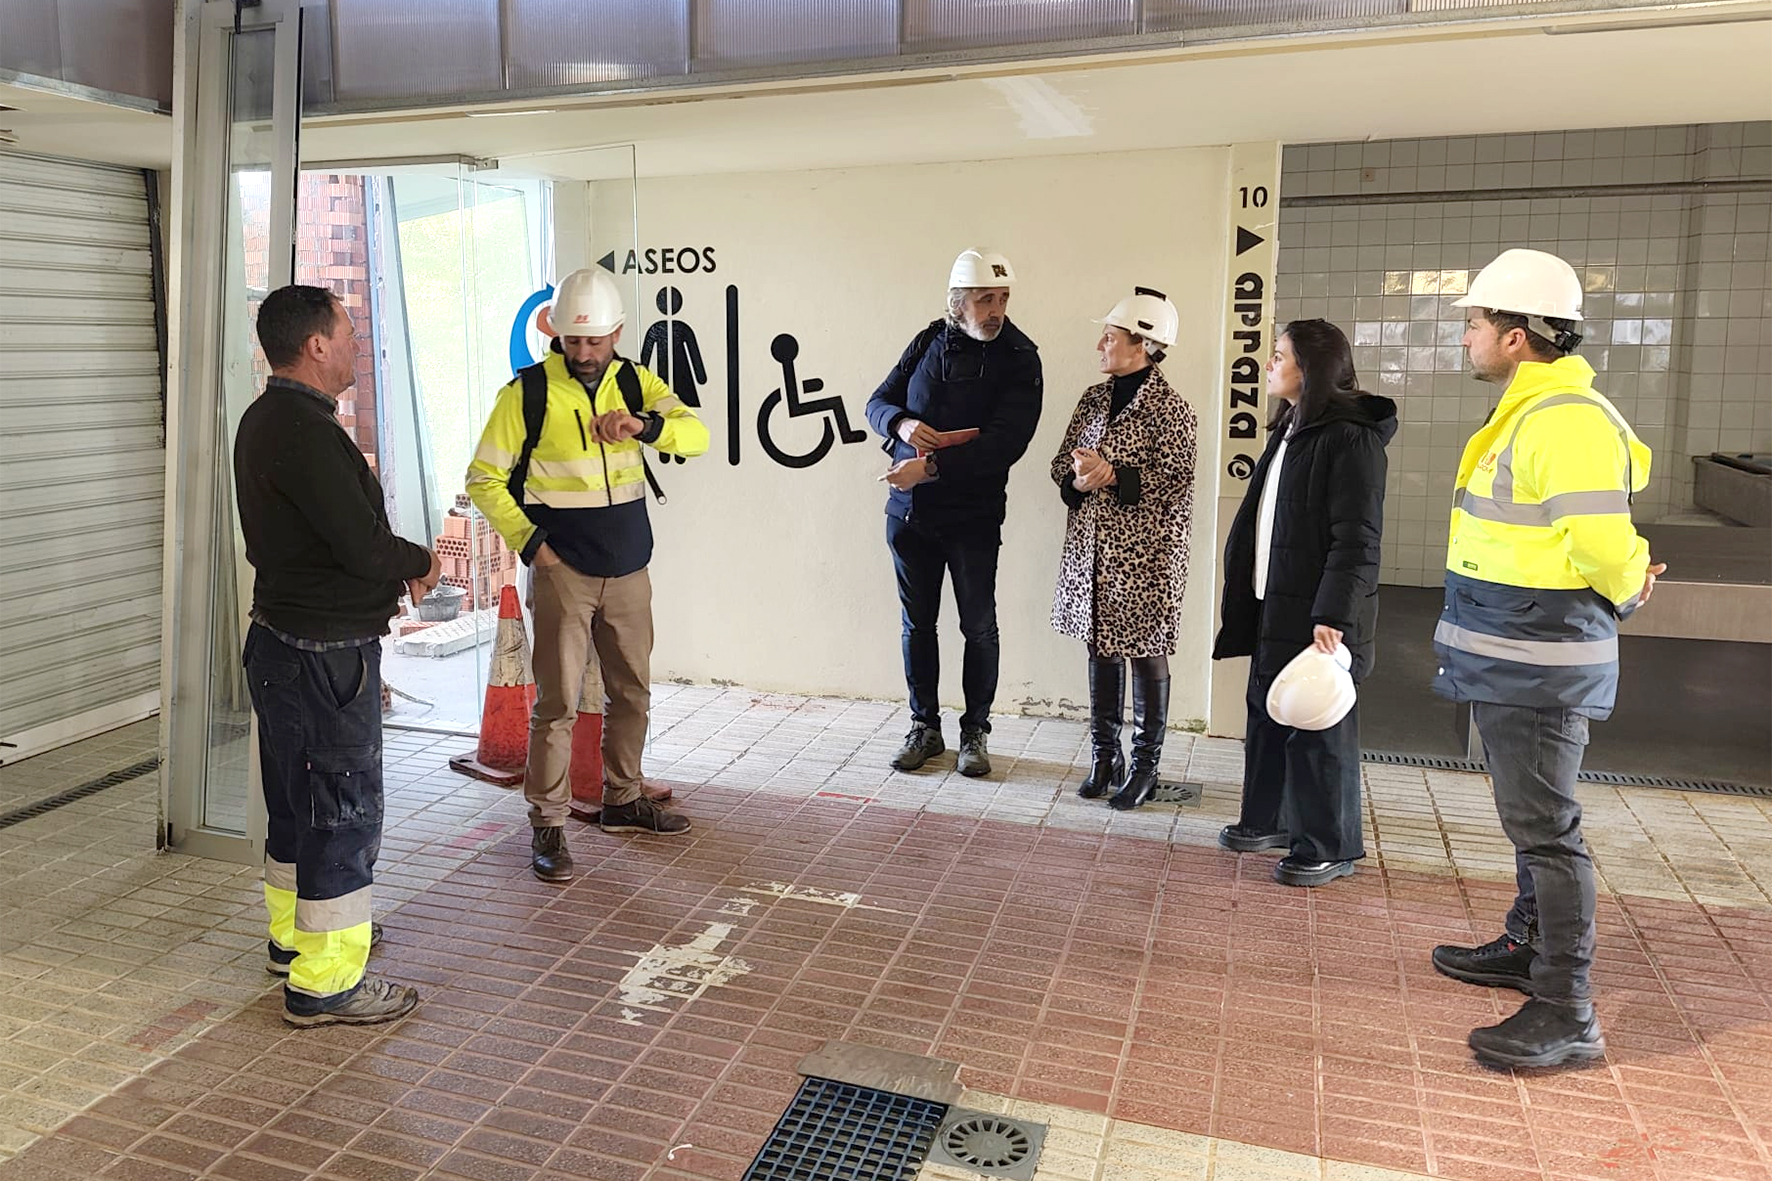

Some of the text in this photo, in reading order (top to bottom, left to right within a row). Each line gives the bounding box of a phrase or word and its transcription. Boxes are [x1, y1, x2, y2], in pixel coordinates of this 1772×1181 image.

[1239, 186, 1268, 209] 10
[622, 246, 717, 275] ASEOS
[1228, 272, 1263, 439] apraza
